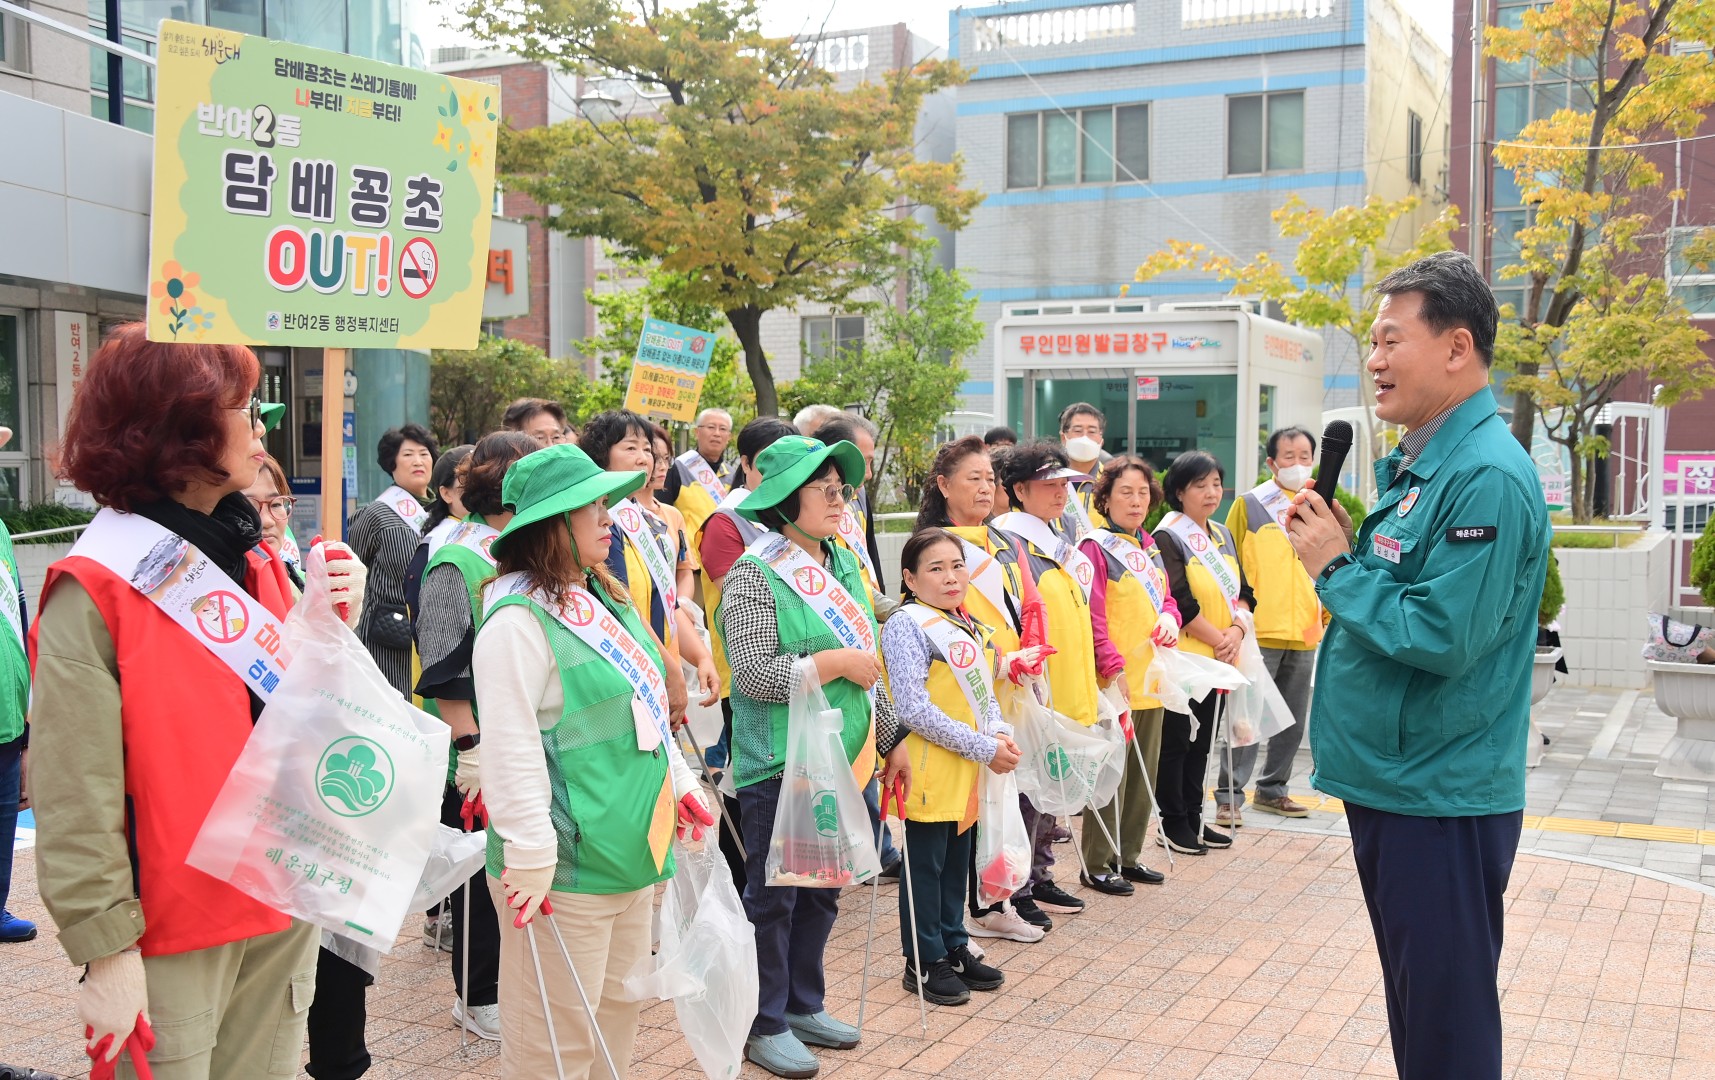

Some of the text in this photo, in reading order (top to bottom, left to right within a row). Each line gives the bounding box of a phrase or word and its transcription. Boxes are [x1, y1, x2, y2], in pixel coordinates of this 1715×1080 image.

[201, 37, 240, 65] 해운대
[274, 57, 417, 101] 담배꽁초는 쓰레기통에!
[197, 101, 302, 148] 반여2동
[295, 88, 402, 122] 나부터! 지금부터!
[222, 149, 443, 233] 담배꽁초
[264, 224, 394, 297] OUT!
[485, 249, 514, 295] 터
[283, 313, 400, 334] 반여2동 행정복지센터
[1019, 332, 1168, 356] 무인민원발급창구
[1456, 529, 1484, 538] 해운대구
[823, 607, 857, 646] 아름다운
[599, 638, 641, 685] 아름다운
[264, 845, 354, 895] 해운대구청
